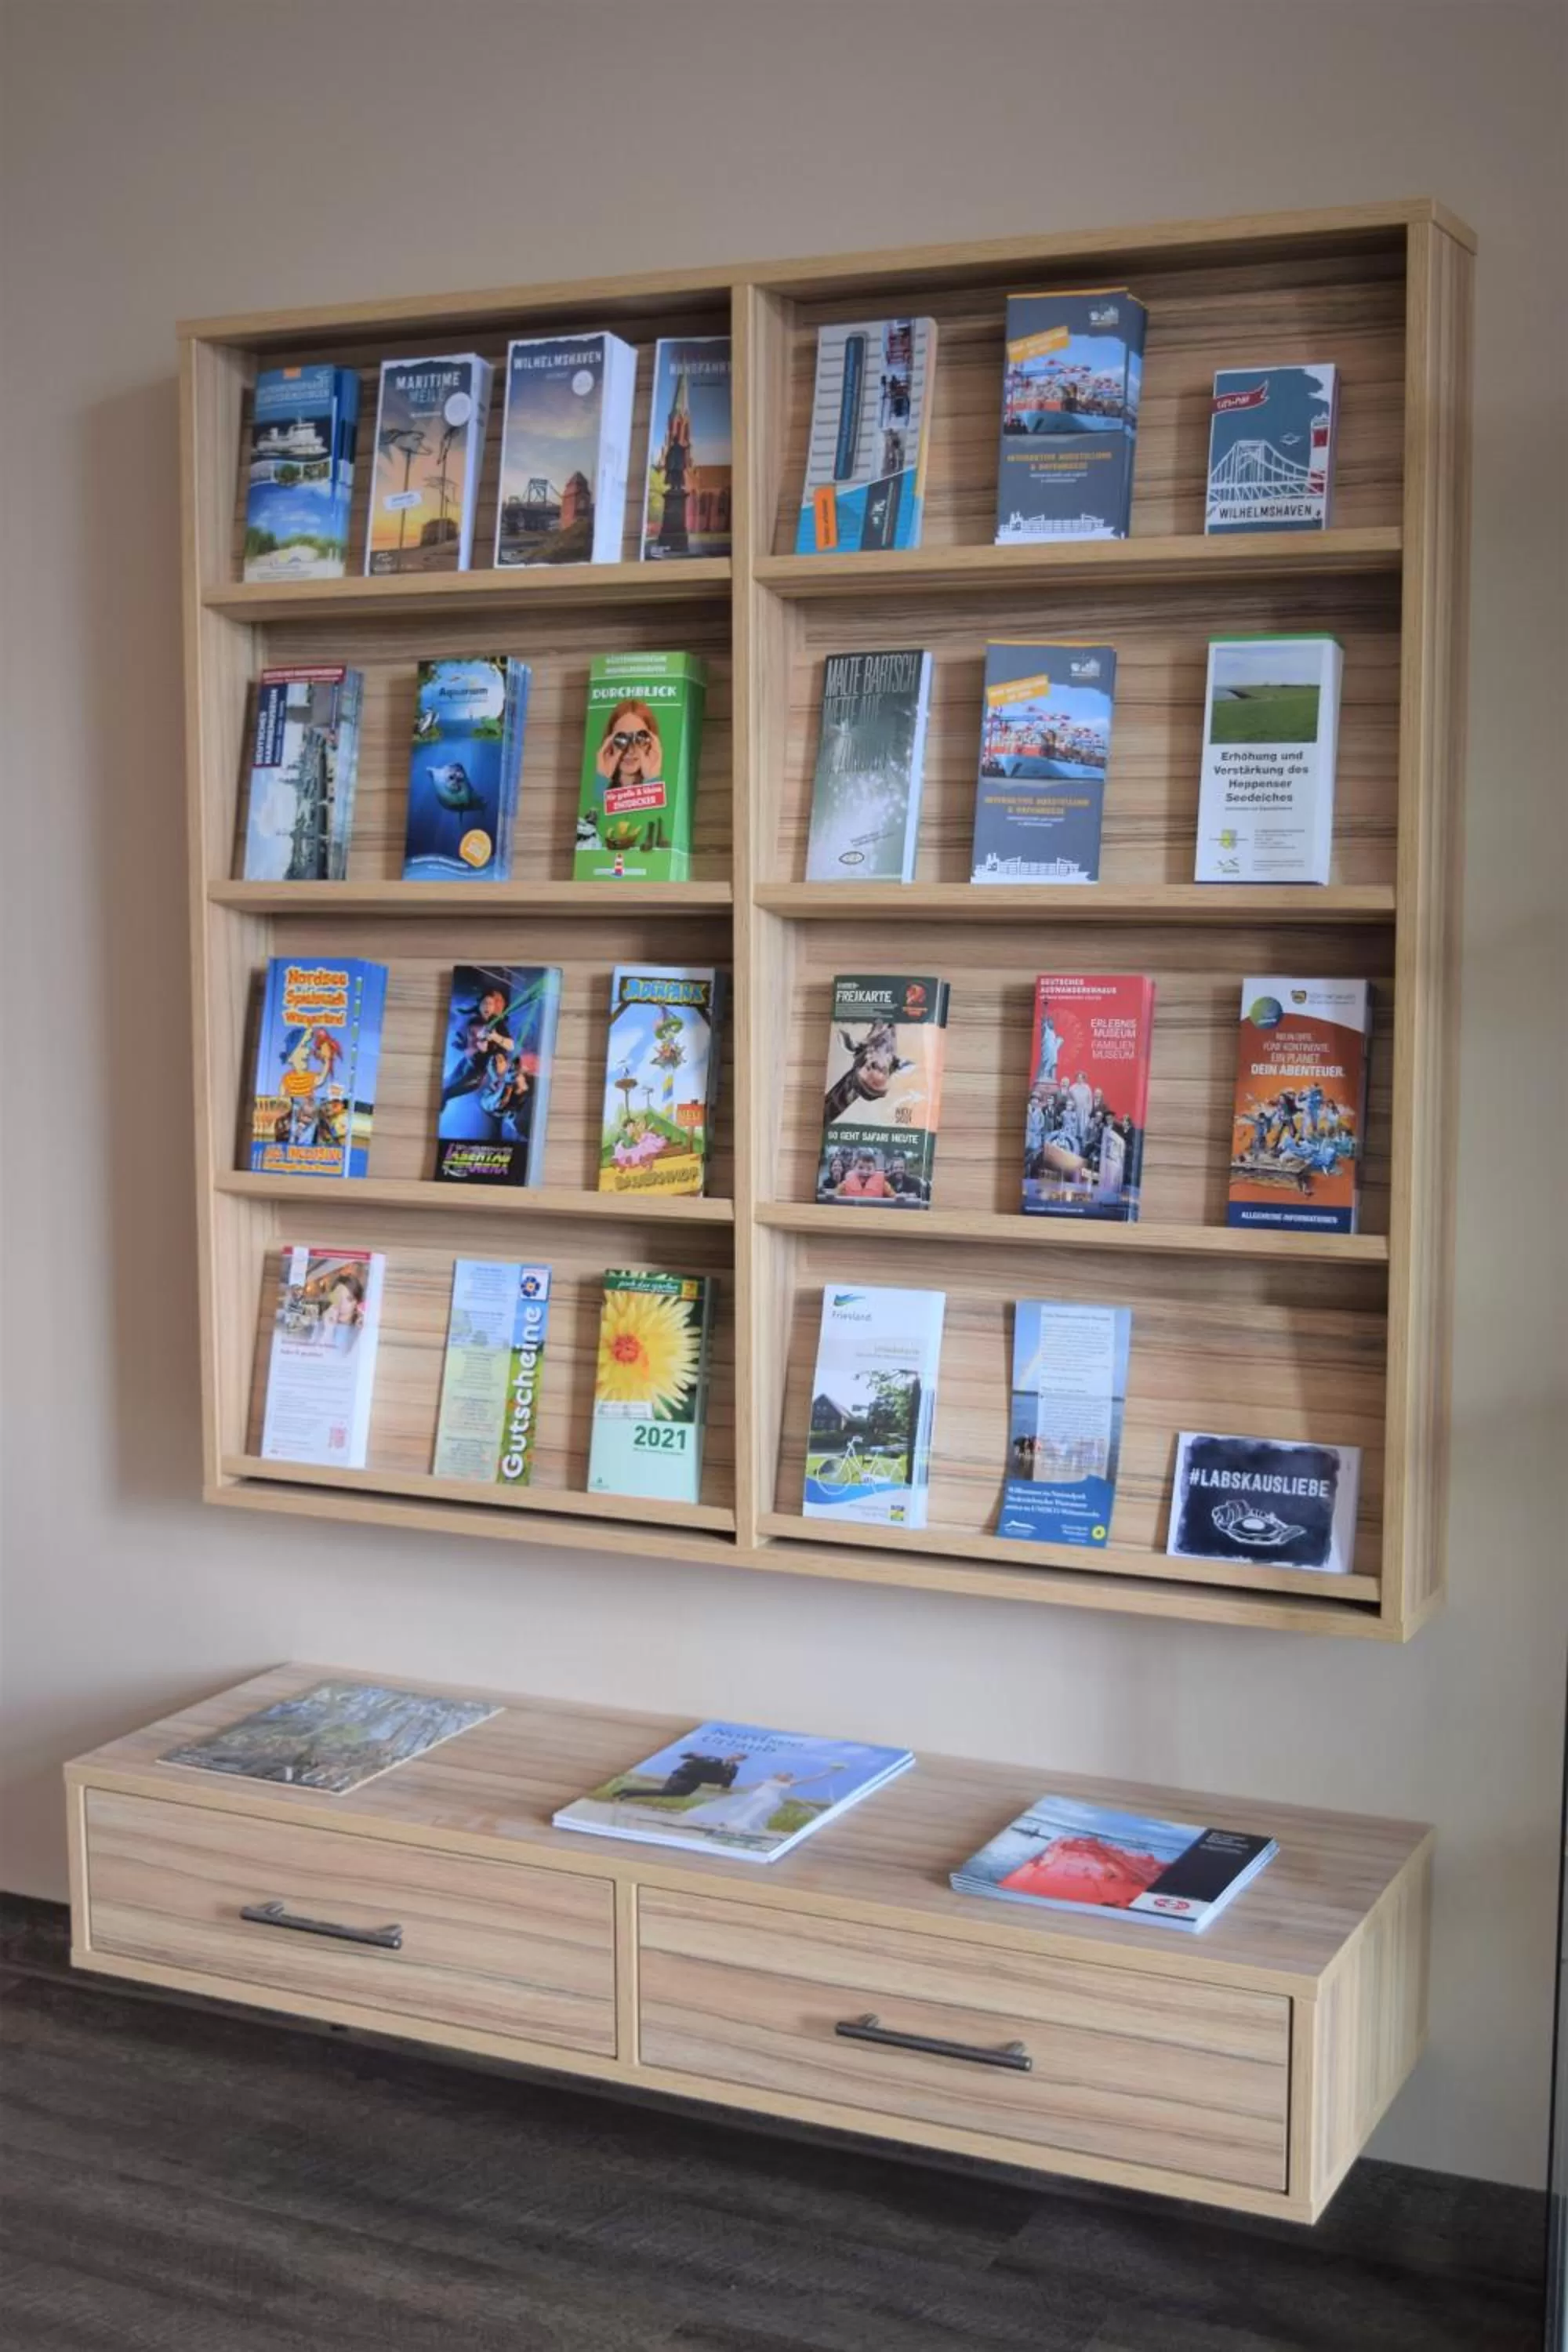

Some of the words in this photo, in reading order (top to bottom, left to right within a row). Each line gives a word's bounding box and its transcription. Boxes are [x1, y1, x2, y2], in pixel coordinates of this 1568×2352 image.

[514, 350, 602, 369] WILHELMSHAVEN
[395, 371, 461, 390] MARITIME
[1219, 504, 1312, 519] WILHELMSHAVEN
[826, 656, 862, 696] MALTE
[863, 654, 918, 694] BARTSCH
[592, 686, 677, 699] DURCHBLICK
[1221, 751, 1277, 762] Erhöhung
[1281, 751, 1304, 760] und
[1214, 765, 1284, 776] Verstärkung
[1287, 765, 1309, 775] des
[1229, 779, 1292, 790] Heppenser
[1225, 793, 1293, 802] Seedeiches
[287, 968, 347, 985] Nordsee
[836, 989, 893, 1003] FREIKARTE
[1091, 1018, 1136, 1028] ERLEBNIS
[1094, 1029, 1136, 1039] MUSEUM
[1091, 1040, 1135, 1049] FAMILIEN
[1092, 1049, 1134, 1059] MUSEUM
[1250, 1063, 1278, 1076] DEIN
[840, 1131, 860, 1140] GEHT
[862, 1132, 889, 1142] SAFARI
[891, 1134, 920, 1144] HEUTE
[832, 1310, 872, 1322] Friesland
[501, 1306, 542, 1479] Gutscheine
[633, 1425, 686, 1450] 2021
[1189, 1468, 1330, 1497] #LABSKAUSLIEBE
